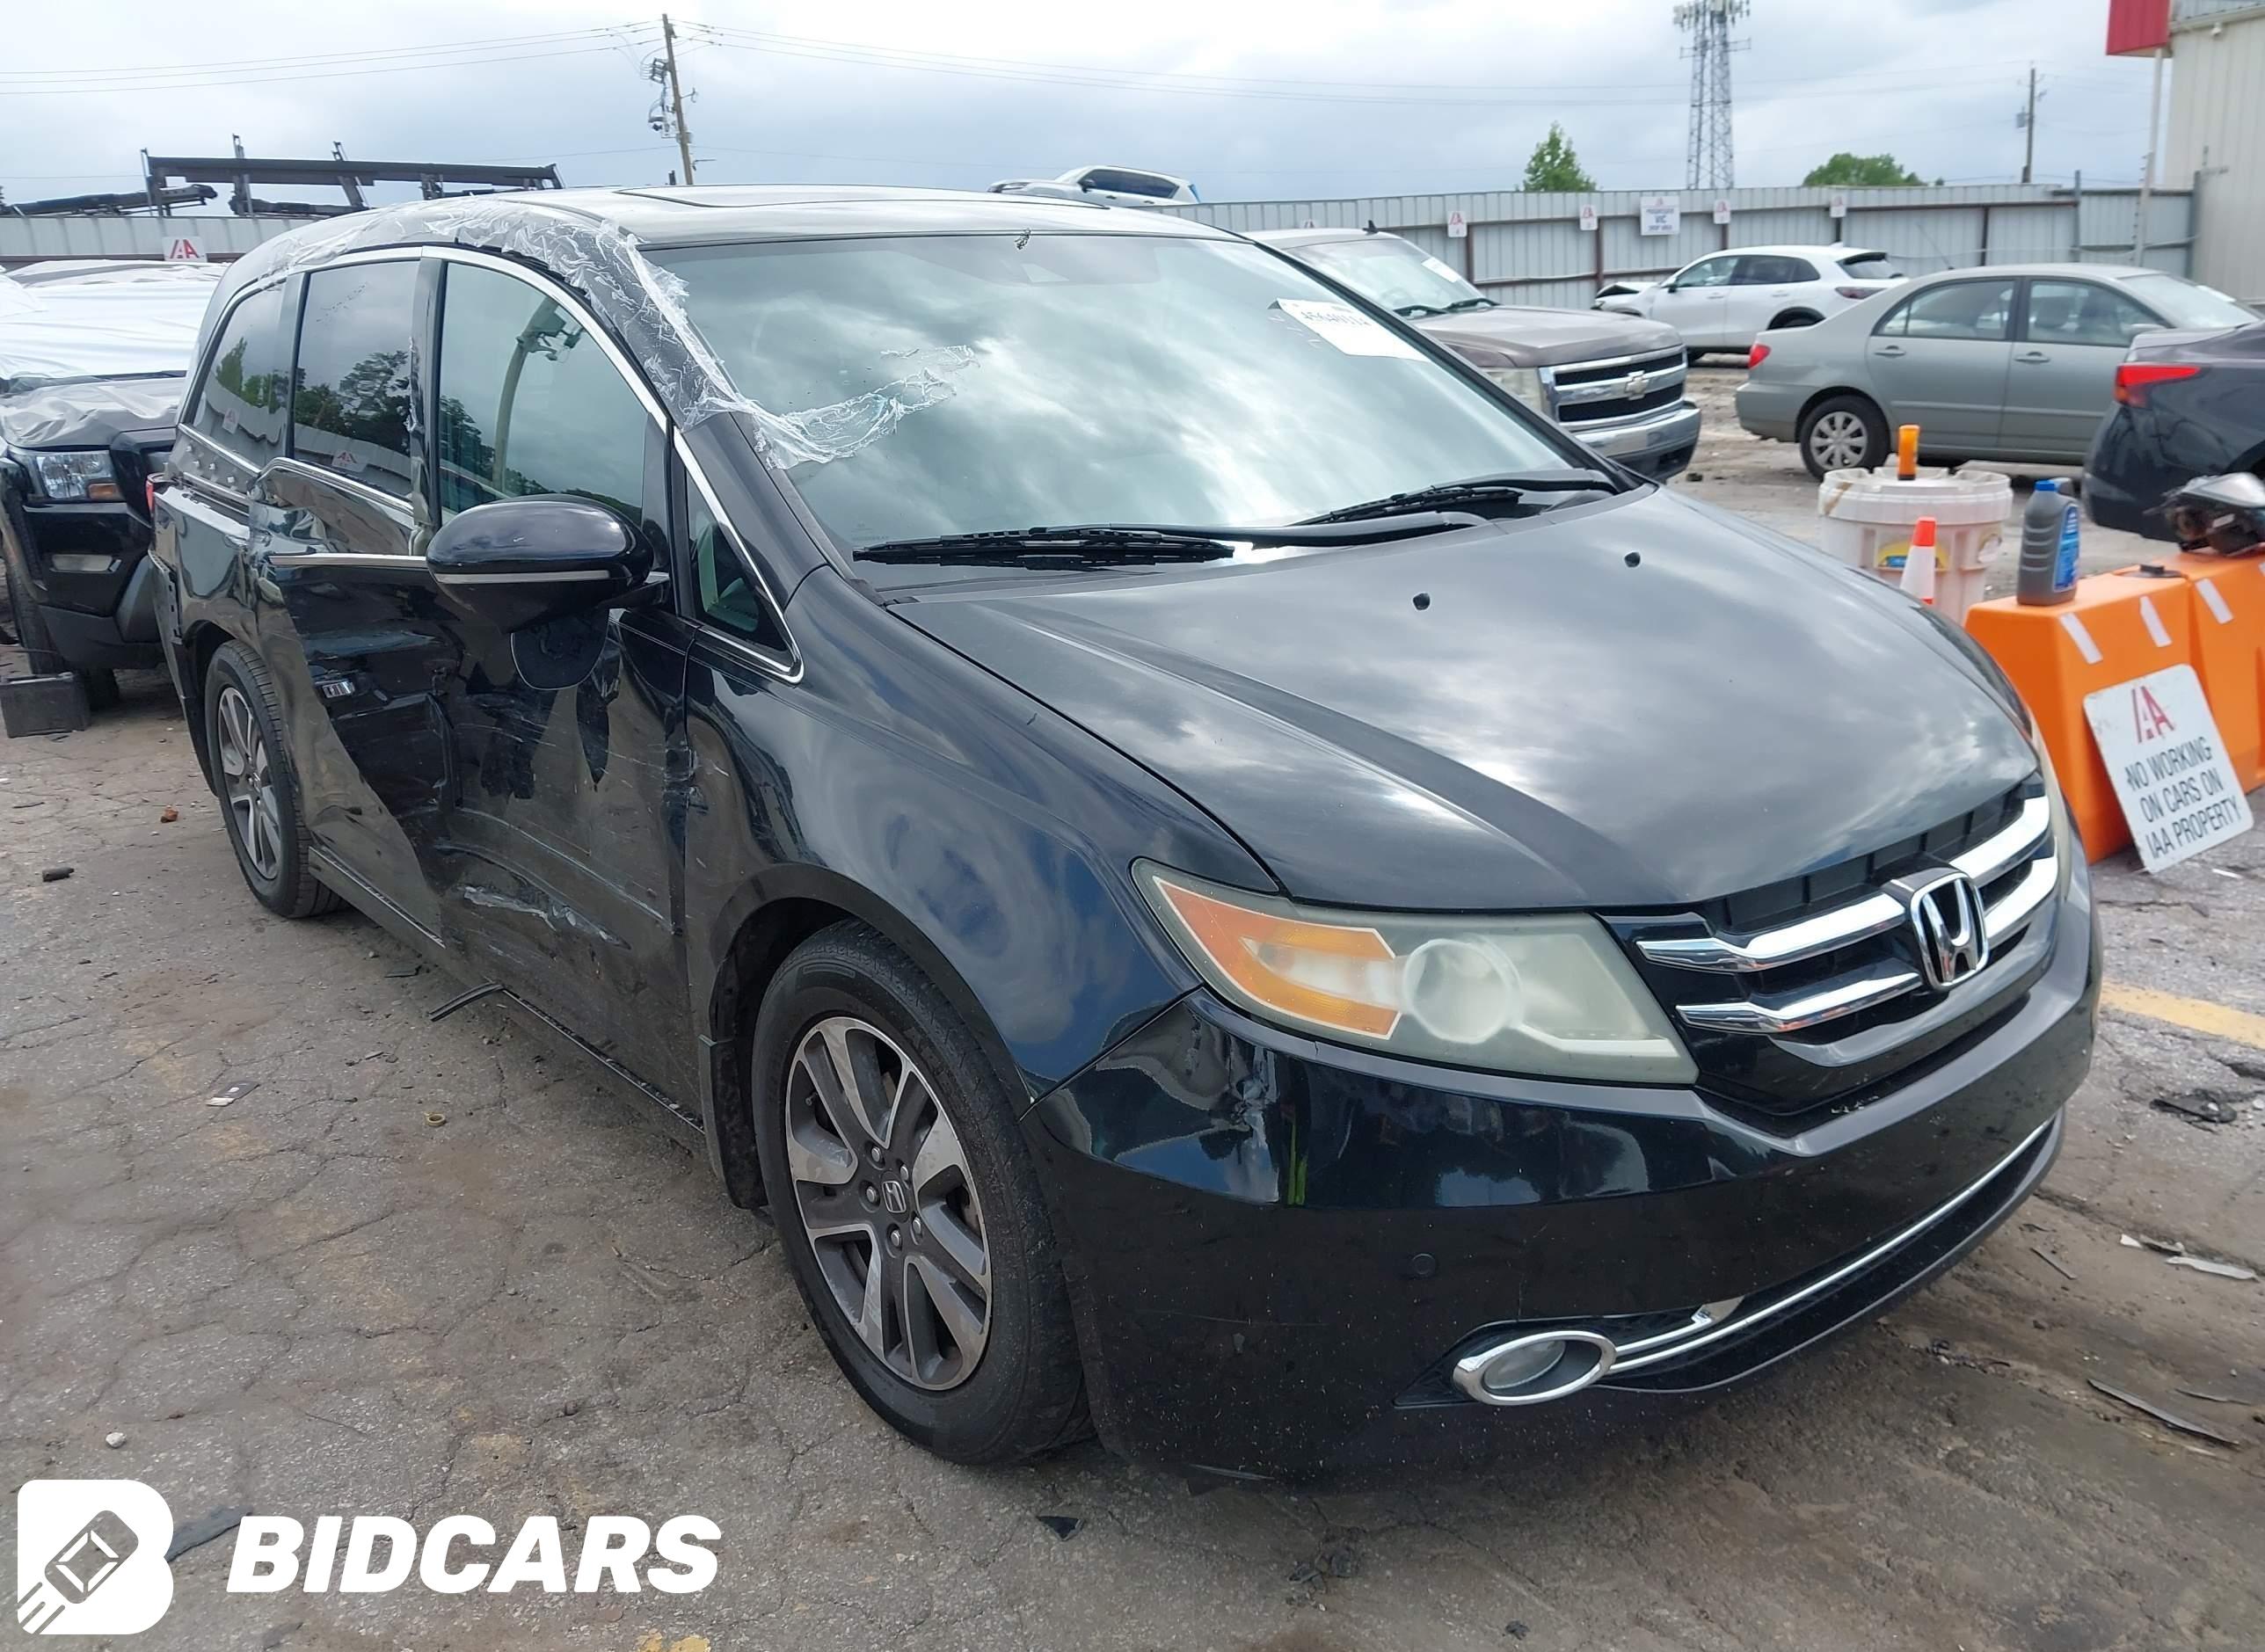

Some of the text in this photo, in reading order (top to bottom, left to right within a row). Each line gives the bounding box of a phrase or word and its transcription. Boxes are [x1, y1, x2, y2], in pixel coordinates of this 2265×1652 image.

[2124, 737, 2213, 791] NO WORKING
[2139, 768, 2224, 823] ON CARS ON
[2145, 796, 2242, 859] IAA PROPERTY
